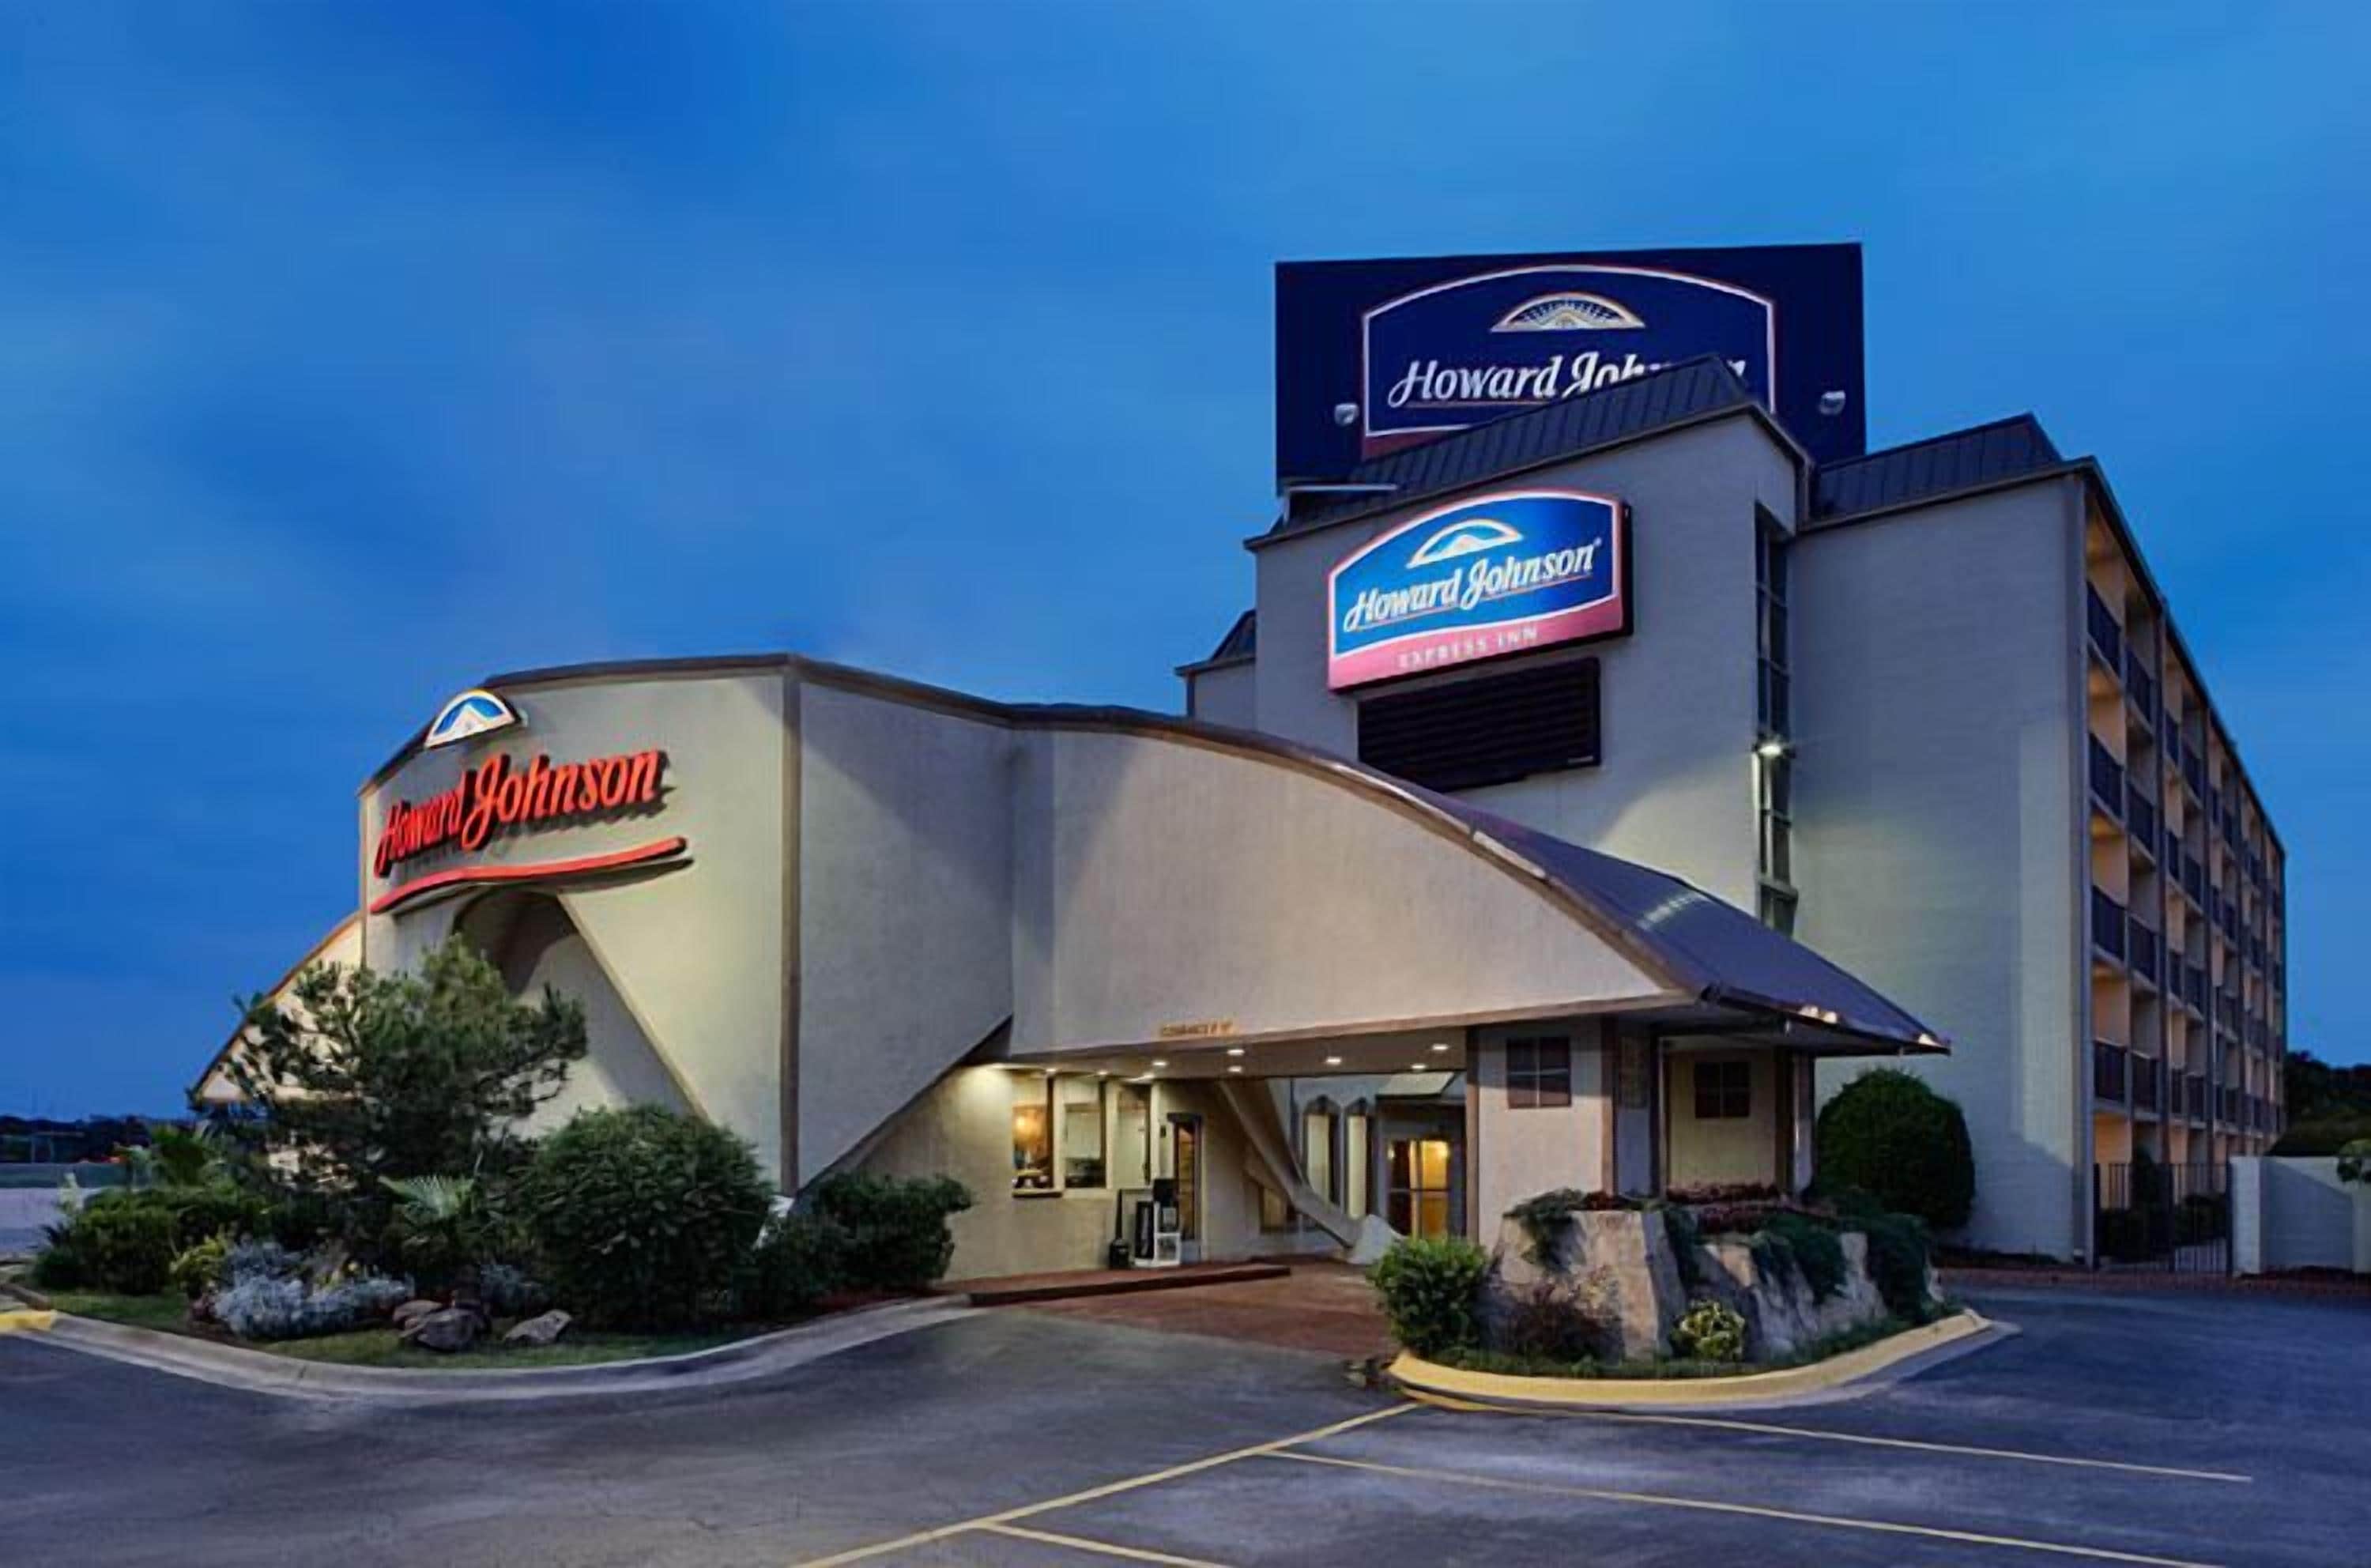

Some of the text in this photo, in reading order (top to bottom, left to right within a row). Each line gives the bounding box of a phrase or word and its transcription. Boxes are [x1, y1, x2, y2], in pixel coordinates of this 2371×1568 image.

[1388, 355, 1562, 408] Howard
[1344, 542, 1594, 631] Howard Johnson
[373, 751, 661, 879] Howard Johnson
